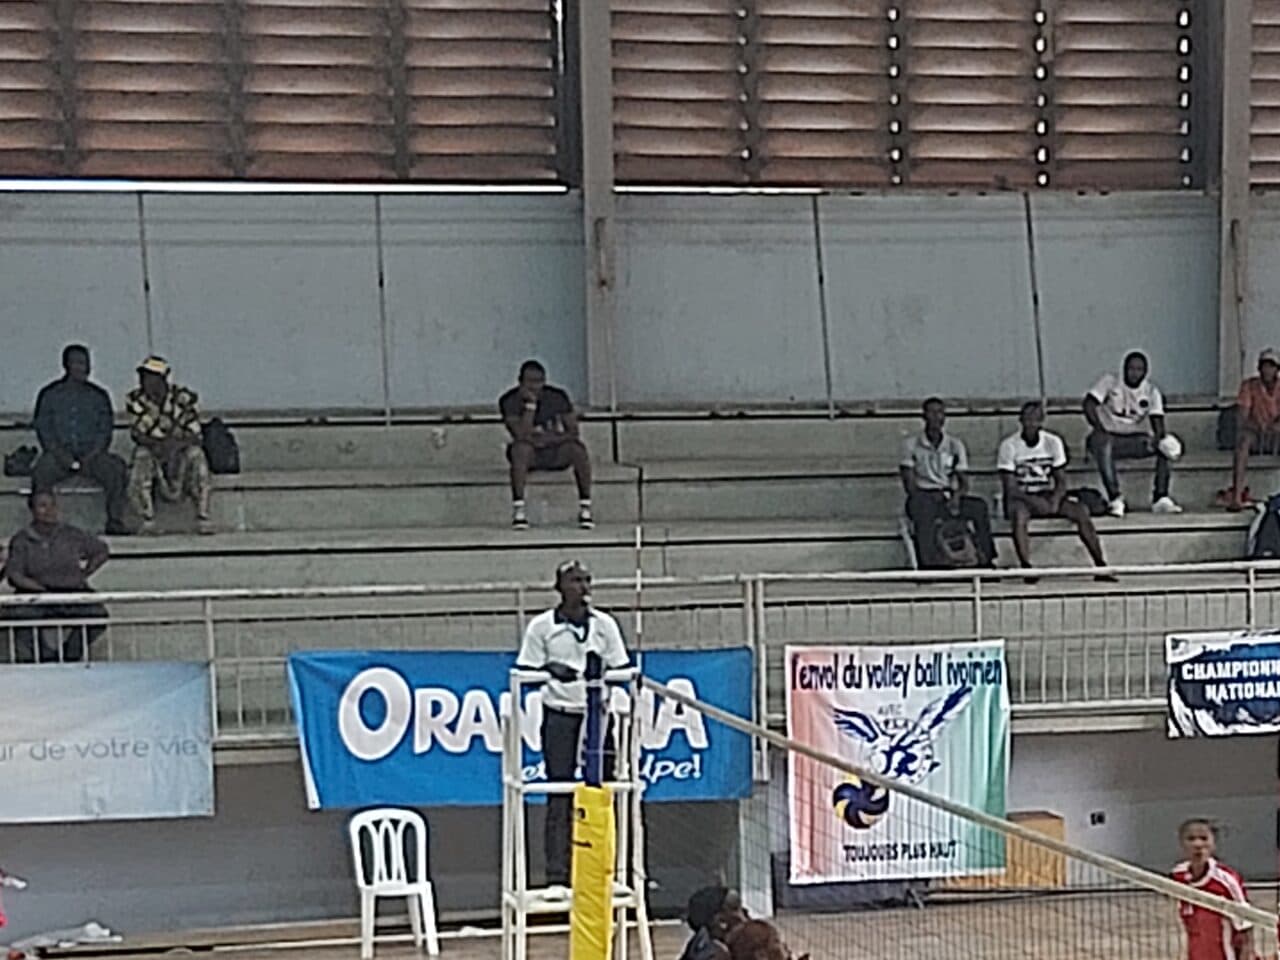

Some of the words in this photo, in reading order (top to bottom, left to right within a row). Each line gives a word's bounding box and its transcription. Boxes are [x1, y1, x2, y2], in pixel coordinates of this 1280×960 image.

[843, 653, 862, 688] du
[866, 653, 911, 698] volley
[914, 653, 942, 688] ball
[947, 652, 1002, 688] ivoirien
[29, 738, 67, 761] de
[74, 738, 150, 759] votre
[158, 738, 198, 756] vie
[843, 842, 899, 862] TOUJOURS
[902, 841, 927, 860] PLUS
[929, 839, 957, 858] HAUT
